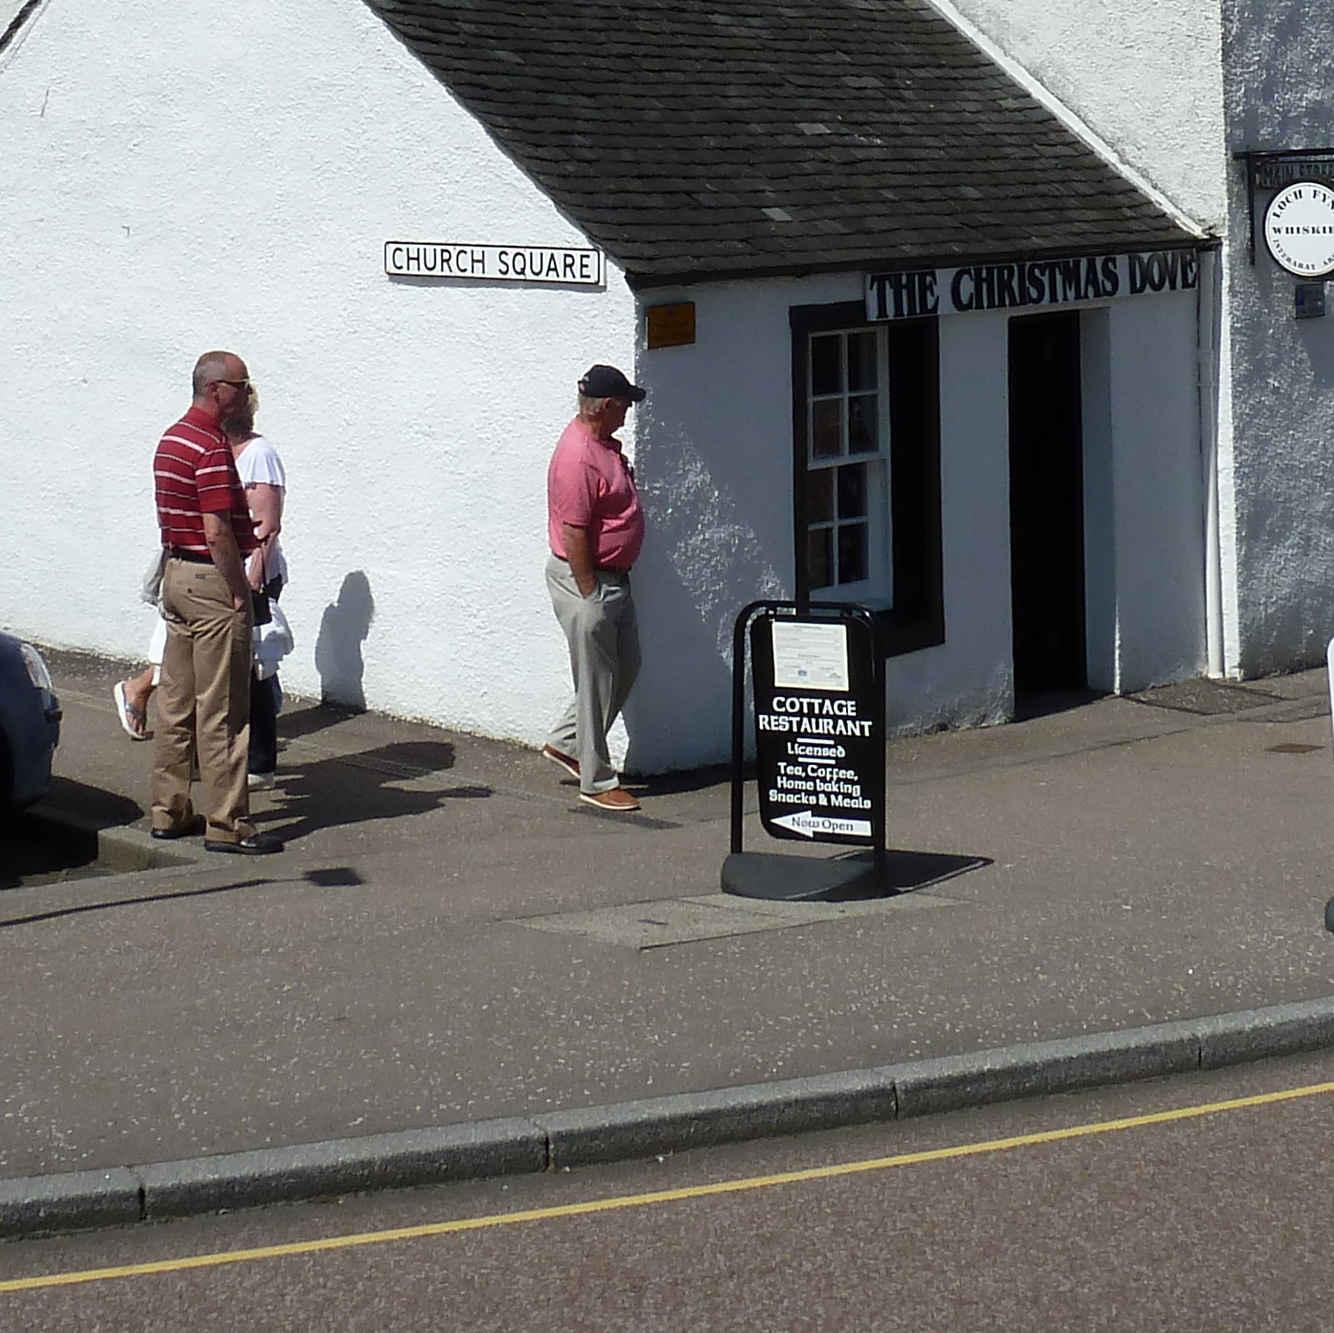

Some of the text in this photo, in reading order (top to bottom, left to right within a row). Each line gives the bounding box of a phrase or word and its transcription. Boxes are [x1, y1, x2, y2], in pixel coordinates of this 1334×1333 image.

[1272, 189, 1303, 219] LOCH
[392, 247, 592, 279] CHURCH SQUARE
[870, 247, 1199, 319] THE CHRISTMAS DOVE
[772, 696, 857, 716] COTTAGE
[758, 714, 873, 737] RESTAURANT
[787, 742, 846, 758] Licensed
[777, 762, 858, 781] Tea, Coffee,
[777, 776, 861, 797] Home baking
[769, 789, 872, 809] Snacks & Meals
[791, 816, 854, 834] Now Open
